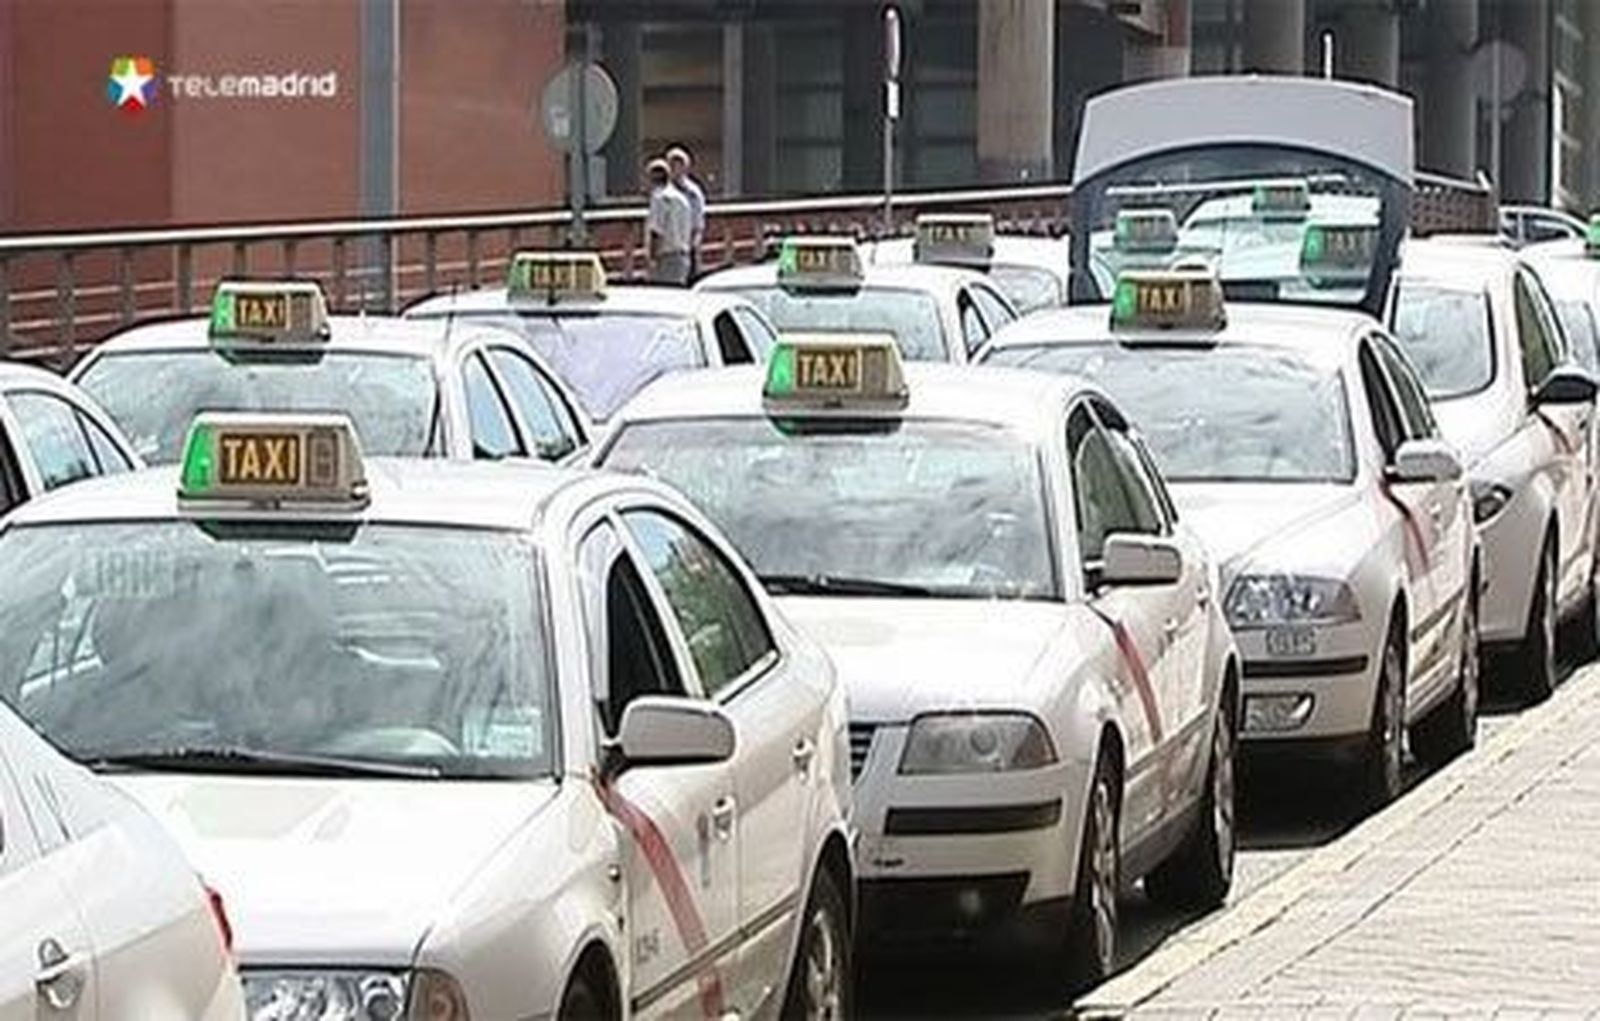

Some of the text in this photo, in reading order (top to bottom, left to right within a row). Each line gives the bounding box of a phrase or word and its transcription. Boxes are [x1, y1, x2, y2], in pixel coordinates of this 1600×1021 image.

[238, 298, 285, 326] TAXI
[1140, 285, 1185, 312] TAXI
[800, 353, 857, 387] TAXI
[223, 438, 298, 481] TAXI
